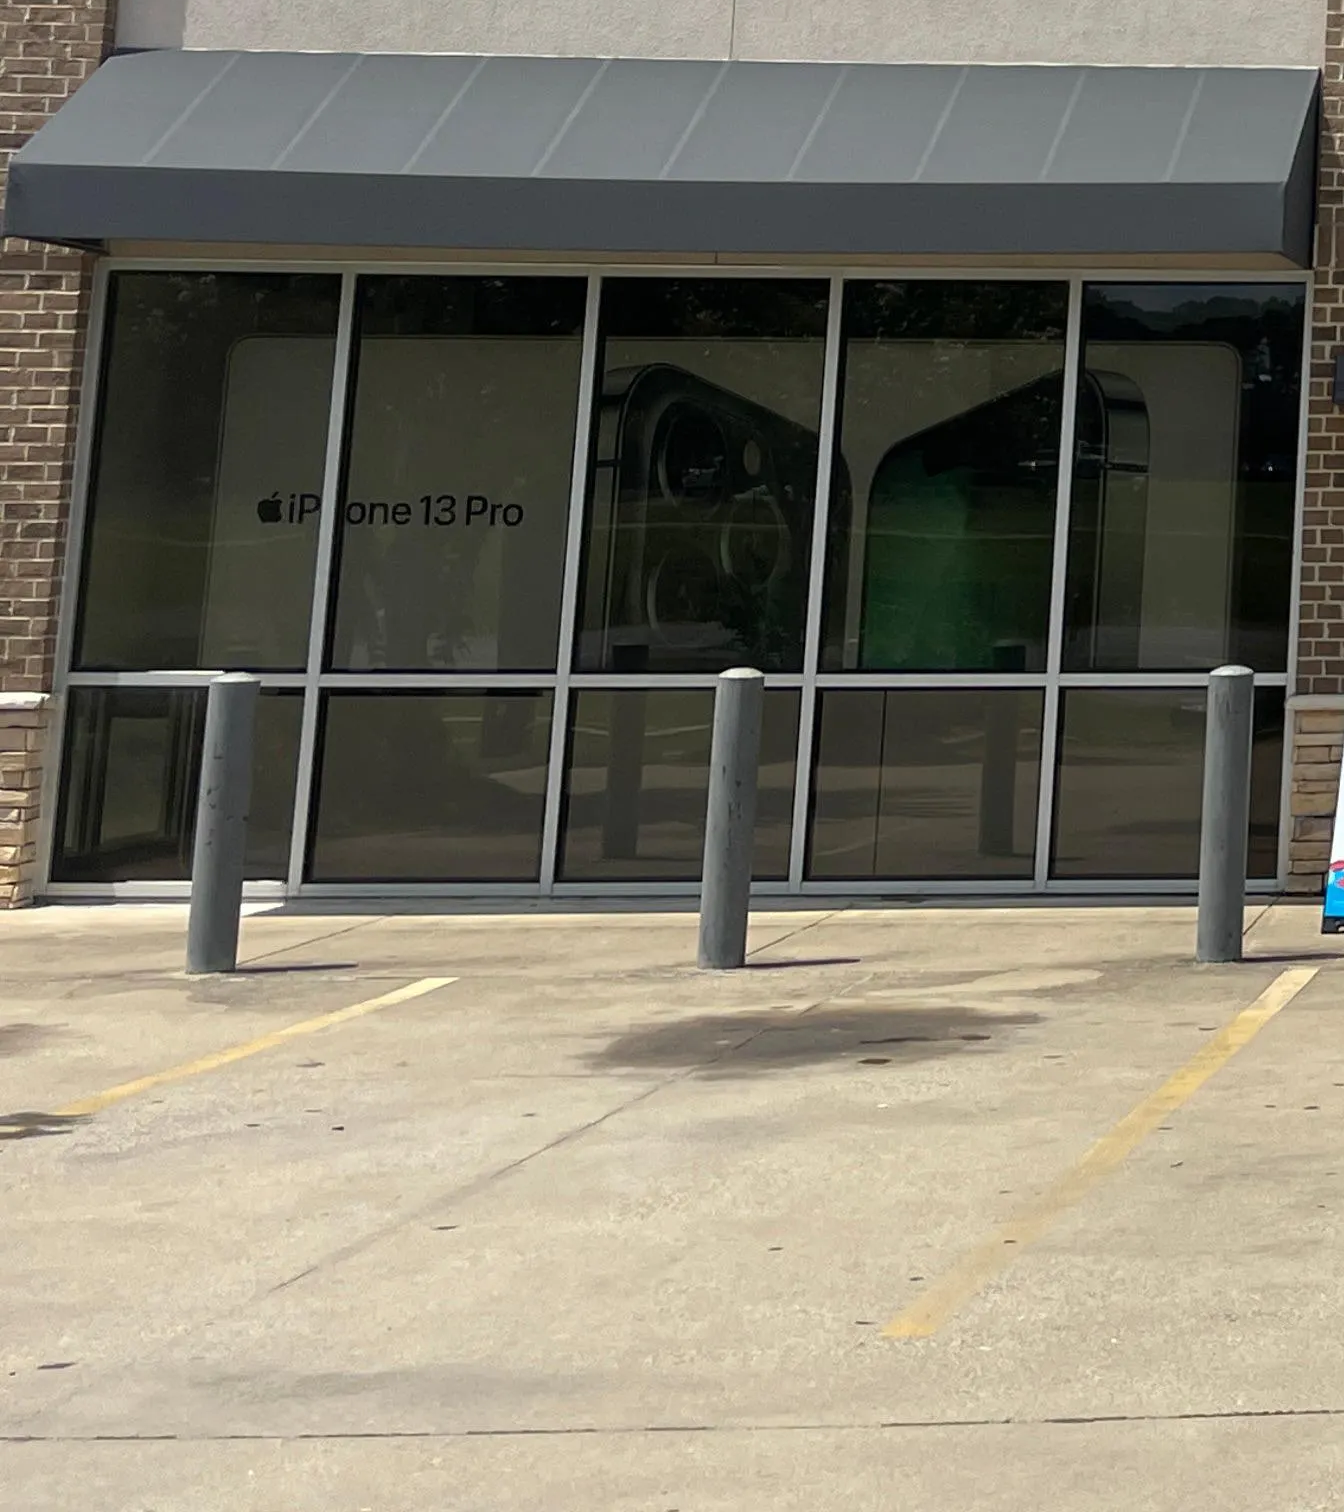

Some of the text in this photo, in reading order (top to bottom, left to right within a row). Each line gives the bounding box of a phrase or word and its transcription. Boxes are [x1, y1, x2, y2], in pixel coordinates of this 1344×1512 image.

[288, 493, 524, 526] iPone 13 Pro
